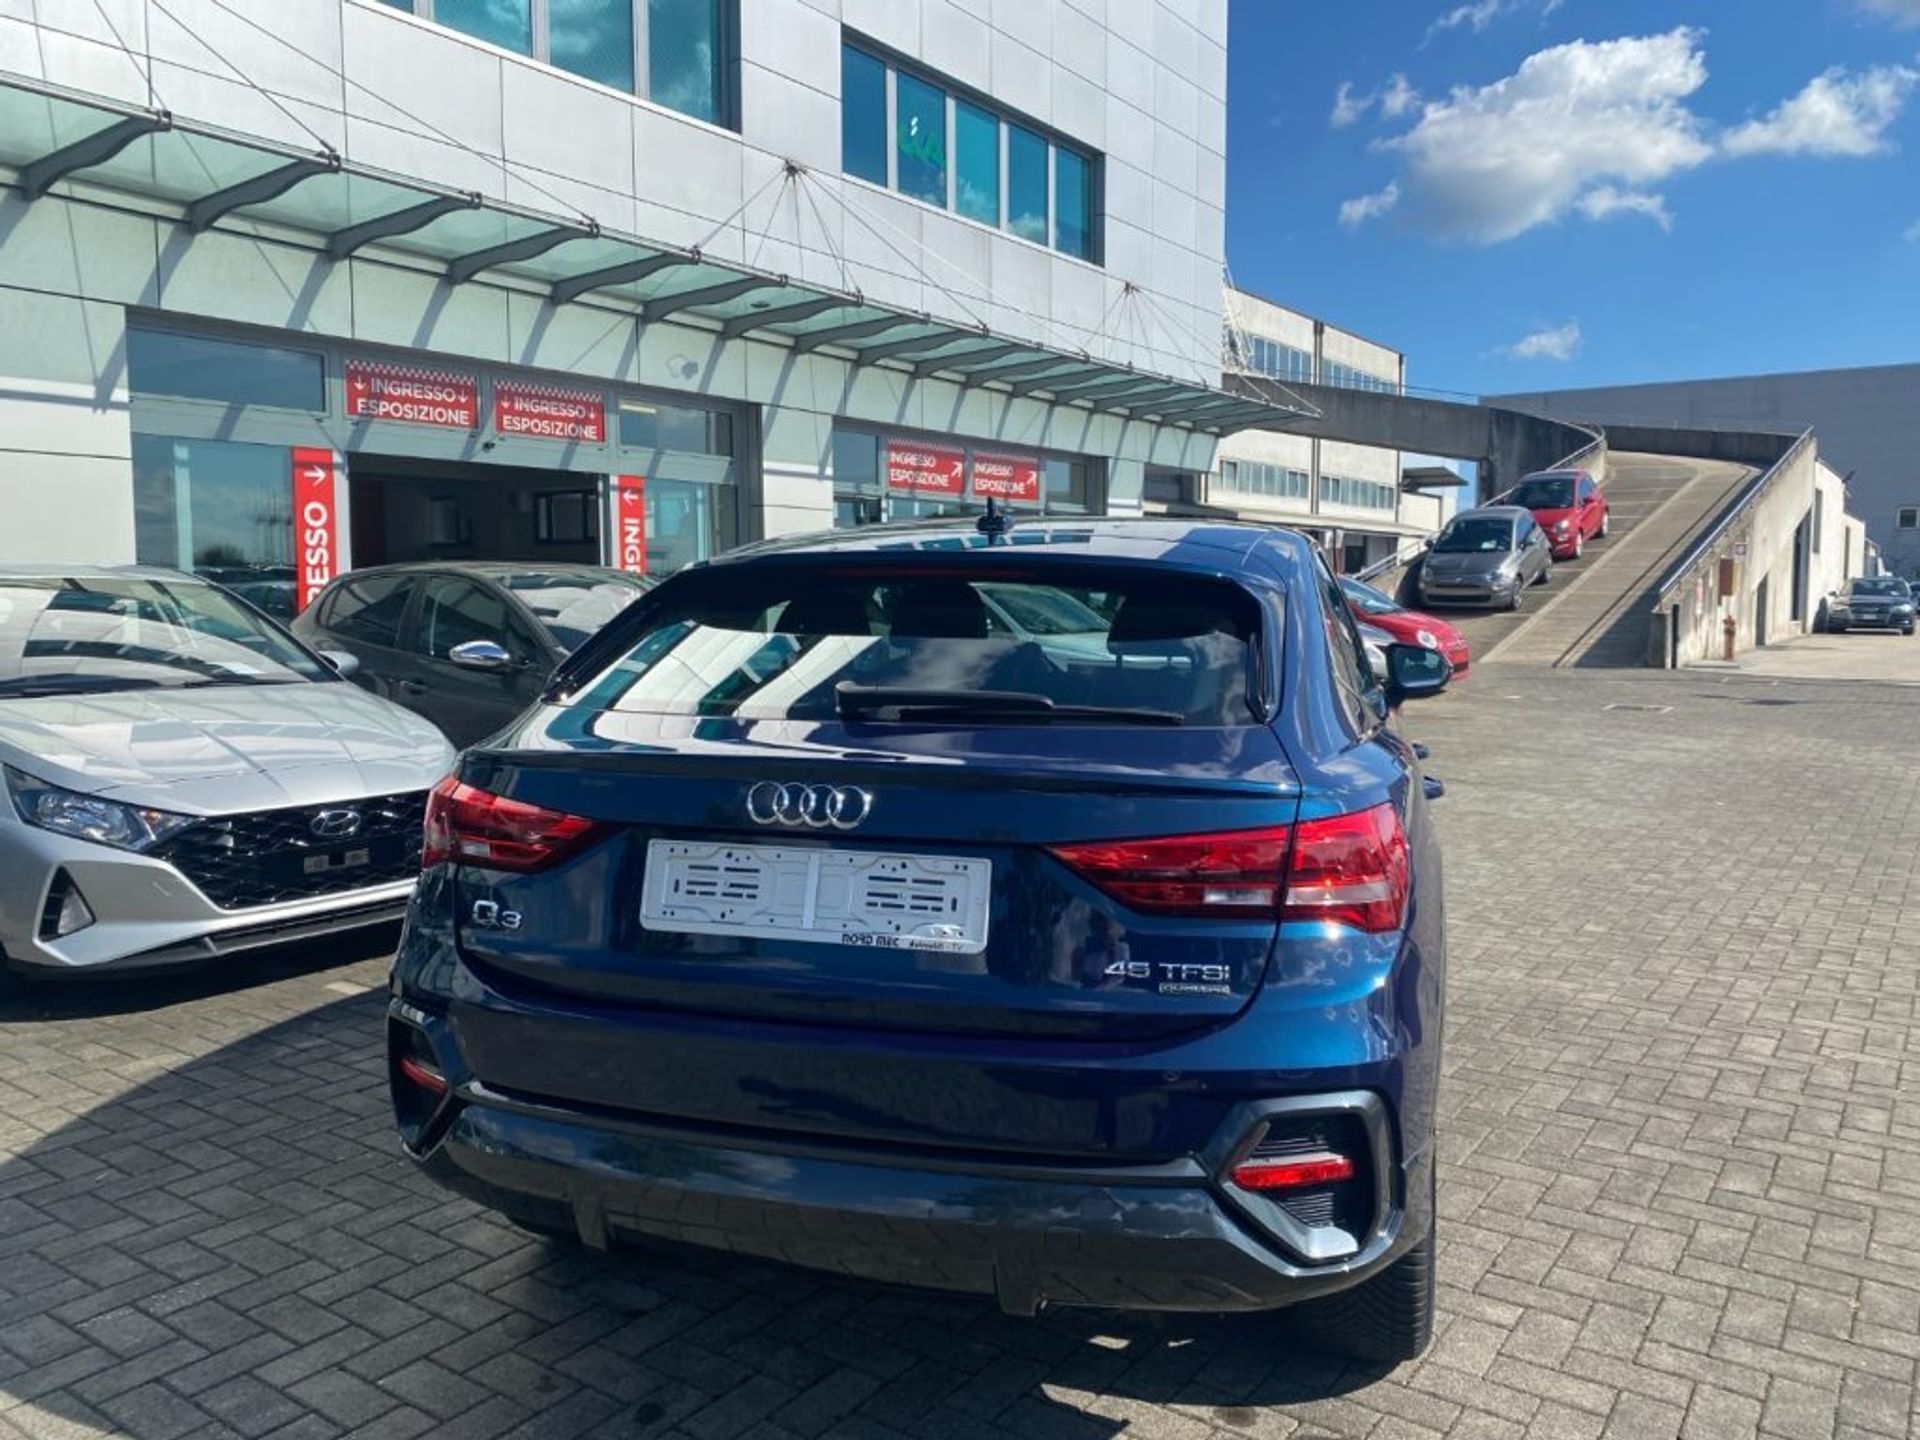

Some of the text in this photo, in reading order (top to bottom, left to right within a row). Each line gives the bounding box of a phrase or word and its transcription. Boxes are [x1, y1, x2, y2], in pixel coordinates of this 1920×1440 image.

[371, 378, 456, 402] INGRESSO
[357, 398, 470, 425] ESPOSIZIONE
[514, 397, 586, 419] INGRESSO
[503, 415, 598, 439] ESPOSIZIONE
[890, 452, 936, 468] INGRESSO
[974, 463, 1013, 477] INGRESSO
[890, 468, 950, 487] ESPOSIZIONE
[975, 478, 1025, 494] ESPOSIZIONE
[472, 900, 522, 929] Q3
[1104, 960, 1150, 979] 45
